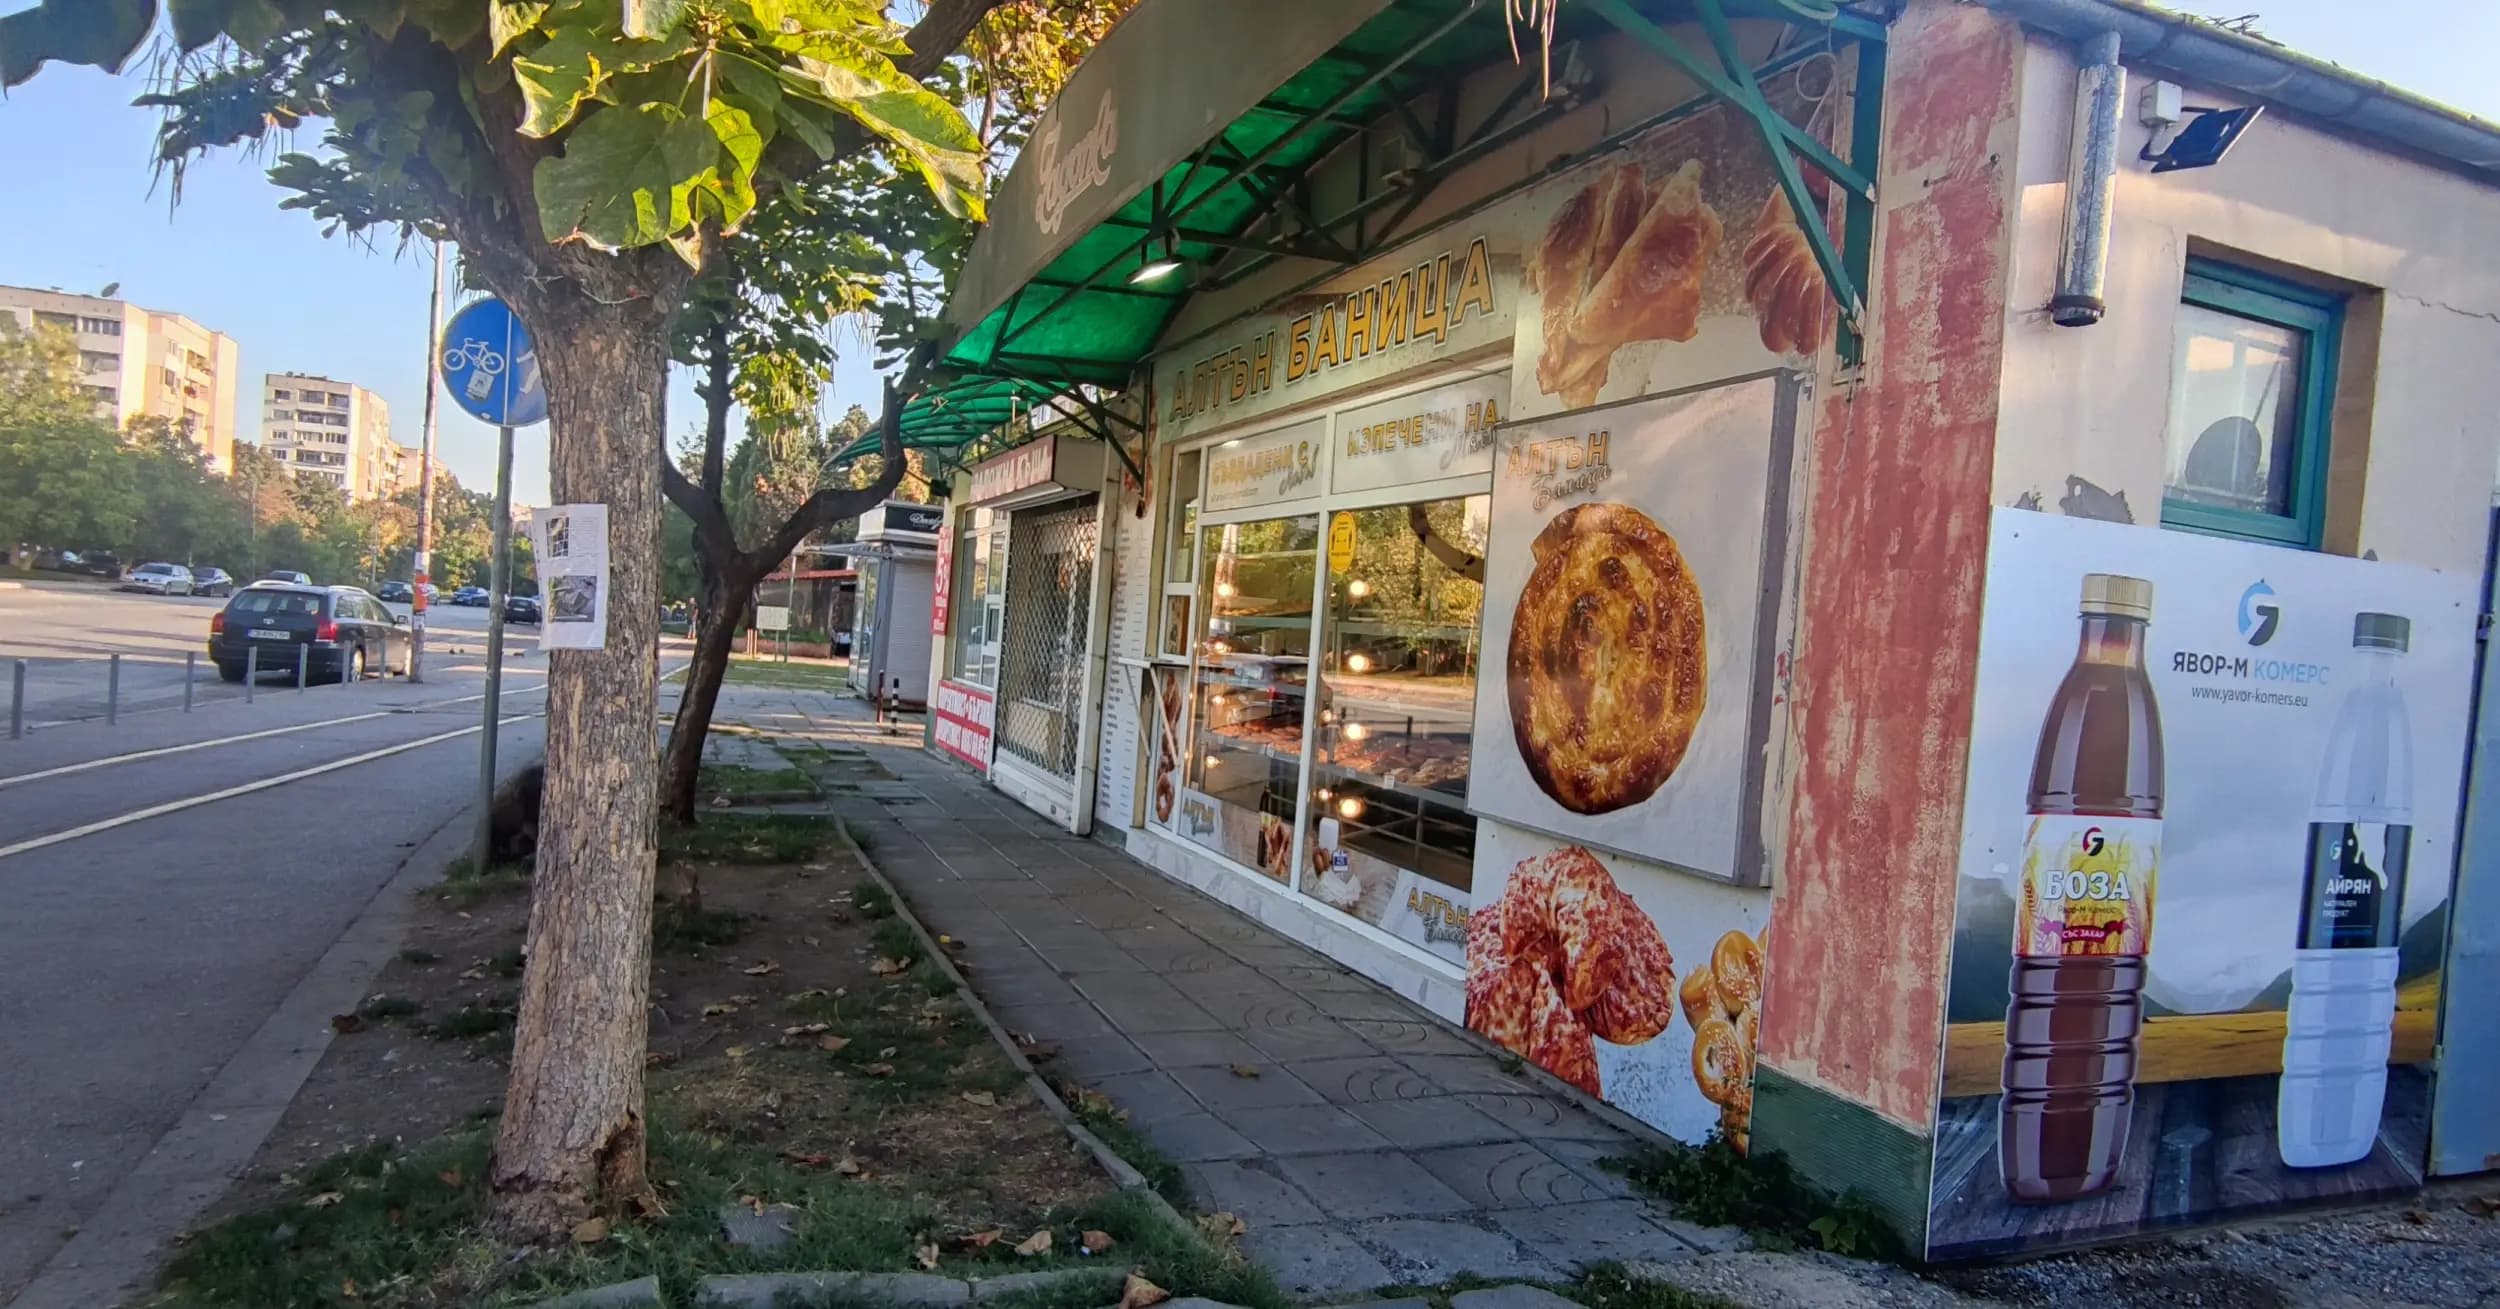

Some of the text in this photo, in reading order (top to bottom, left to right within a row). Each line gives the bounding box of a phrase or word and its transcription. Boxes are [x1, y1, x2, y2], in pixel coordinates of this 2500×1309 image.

[1168, 235, 1495, 424] АЛТЪН БАНИЦА
[1464, 399, 1497, 433] НА
[1505, 430, 1608, 478] АЛТЪН
[1531, 464, 1610, 511] Баница
[2173, 652, 2330, 685] ЯВОР-М КОМЕРС
[2191, 686, 2309, 707] www.yavor-komers.eu
[2043, 869, 2130, 900] БОЗА
[2325, 874, 2372, 894] АЙРЯН
[1407, 887, 1469, 929] АЛТЪН
